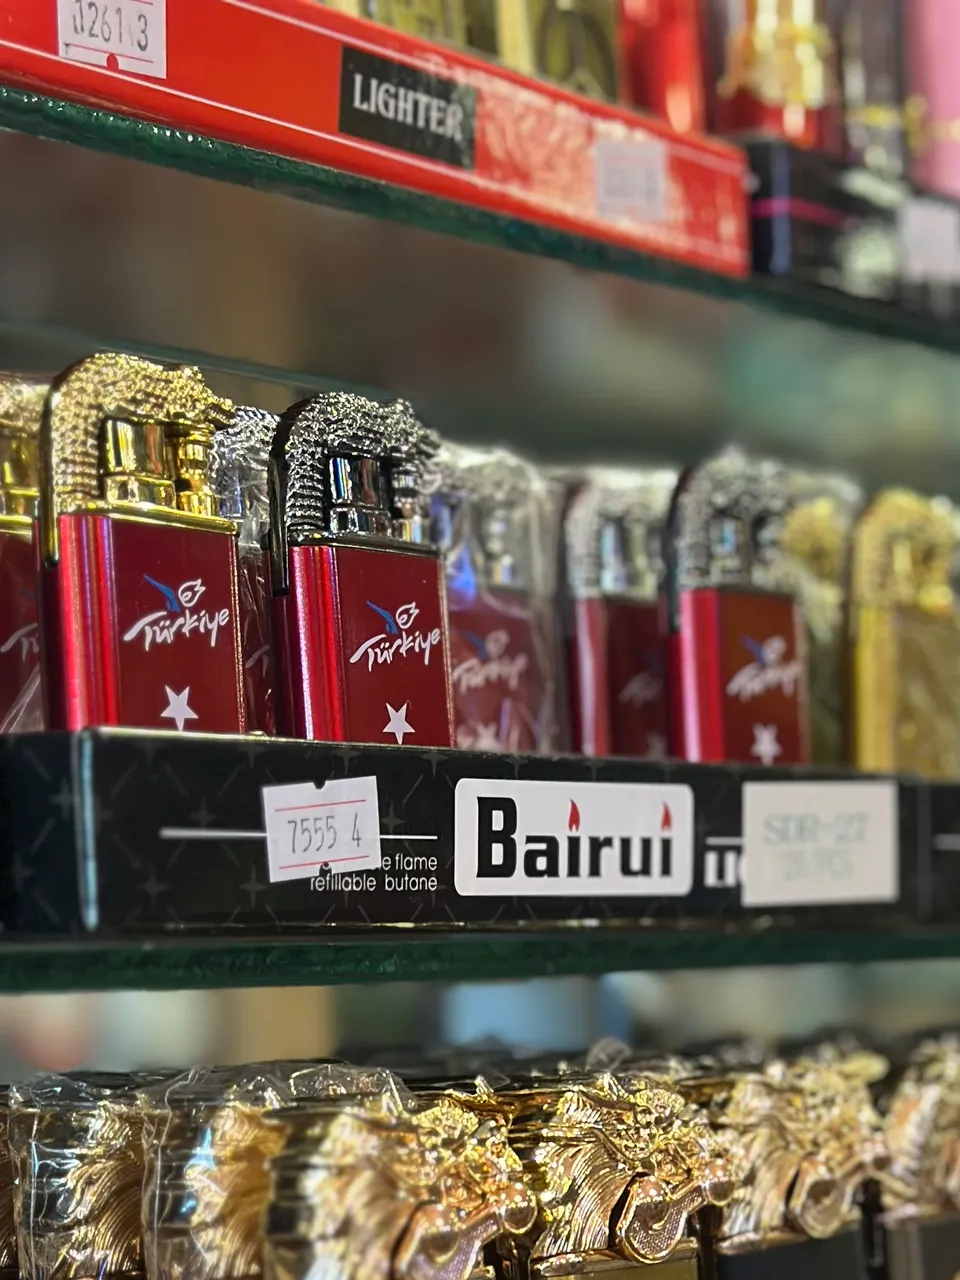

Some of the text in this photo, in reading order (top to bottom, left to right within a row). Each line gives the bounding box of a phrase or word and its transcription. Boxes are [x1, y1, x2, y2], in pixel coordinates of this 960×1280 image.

[353, 72, 464, 142] LIGHTER
[123, 608, 230, 652] Türkiye
[349, 627, 441, 672] Türkiye
[287, 812, 362, 854] 7555 4
[476, 796, 674, 878] Bairui
[310, 873, 438, 892] refillable butane
[395, 852, 438, 871] flame
